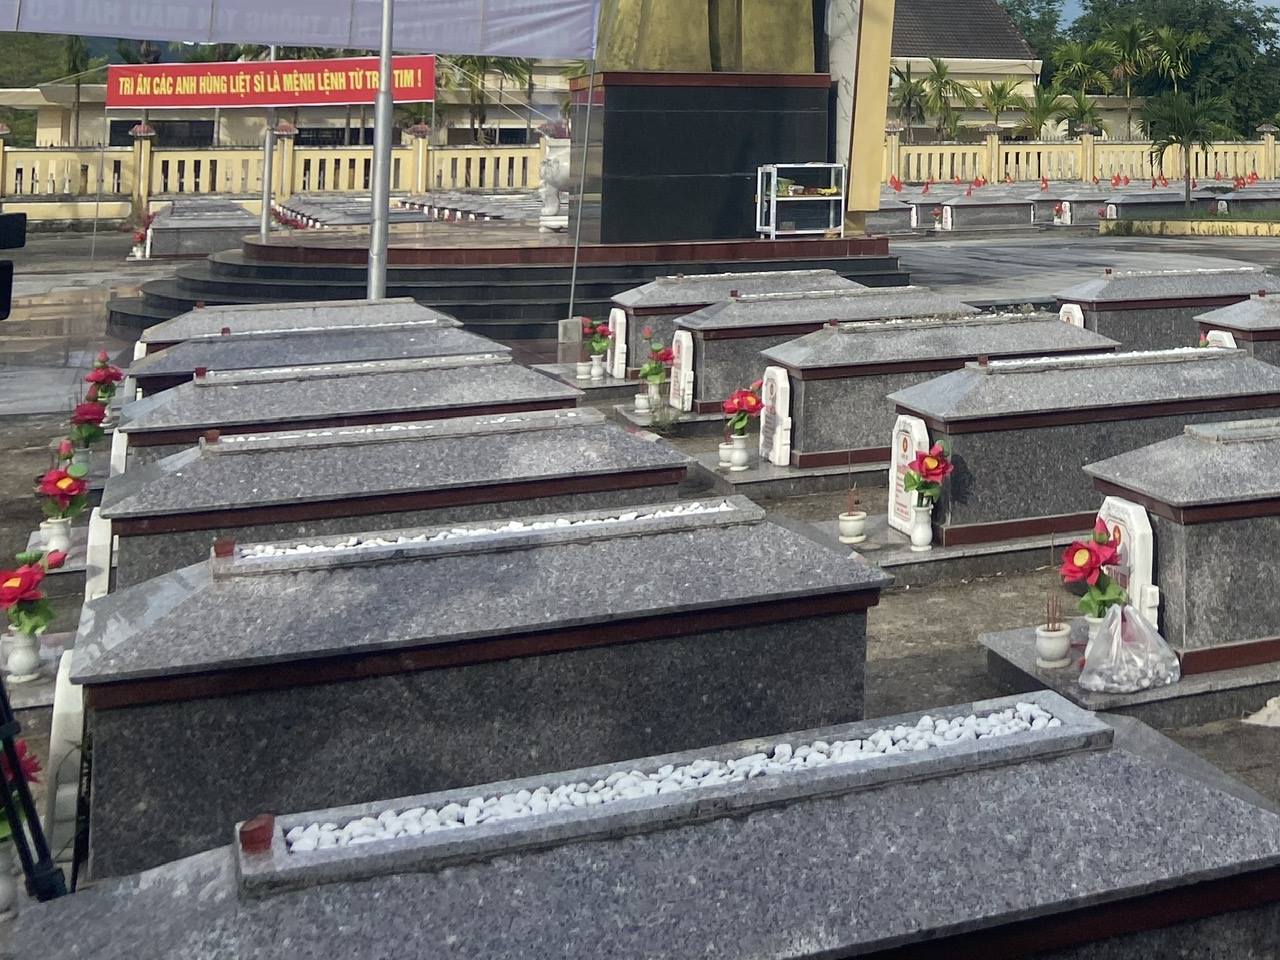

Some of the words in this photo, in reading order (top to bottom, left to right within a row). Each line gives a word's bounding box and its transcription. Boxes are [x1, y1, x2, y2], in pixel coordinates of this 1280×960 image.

[119, 77, 134, 95] TRI
[153, 73, 173, 95] CÁC
[175, 76, 197, 94] ANH
[199, 72, 227, 94] HÙNG
[230, 71, 250, 98] LIỆT
[267, 70, 281, 92] LÀ
[283, 69, 315, 96] MỆNH
[317, 69, 346, 95] LỆNH
[348, 67, 363, 89] TỪ
[393, 69, 414, 88] TIM
